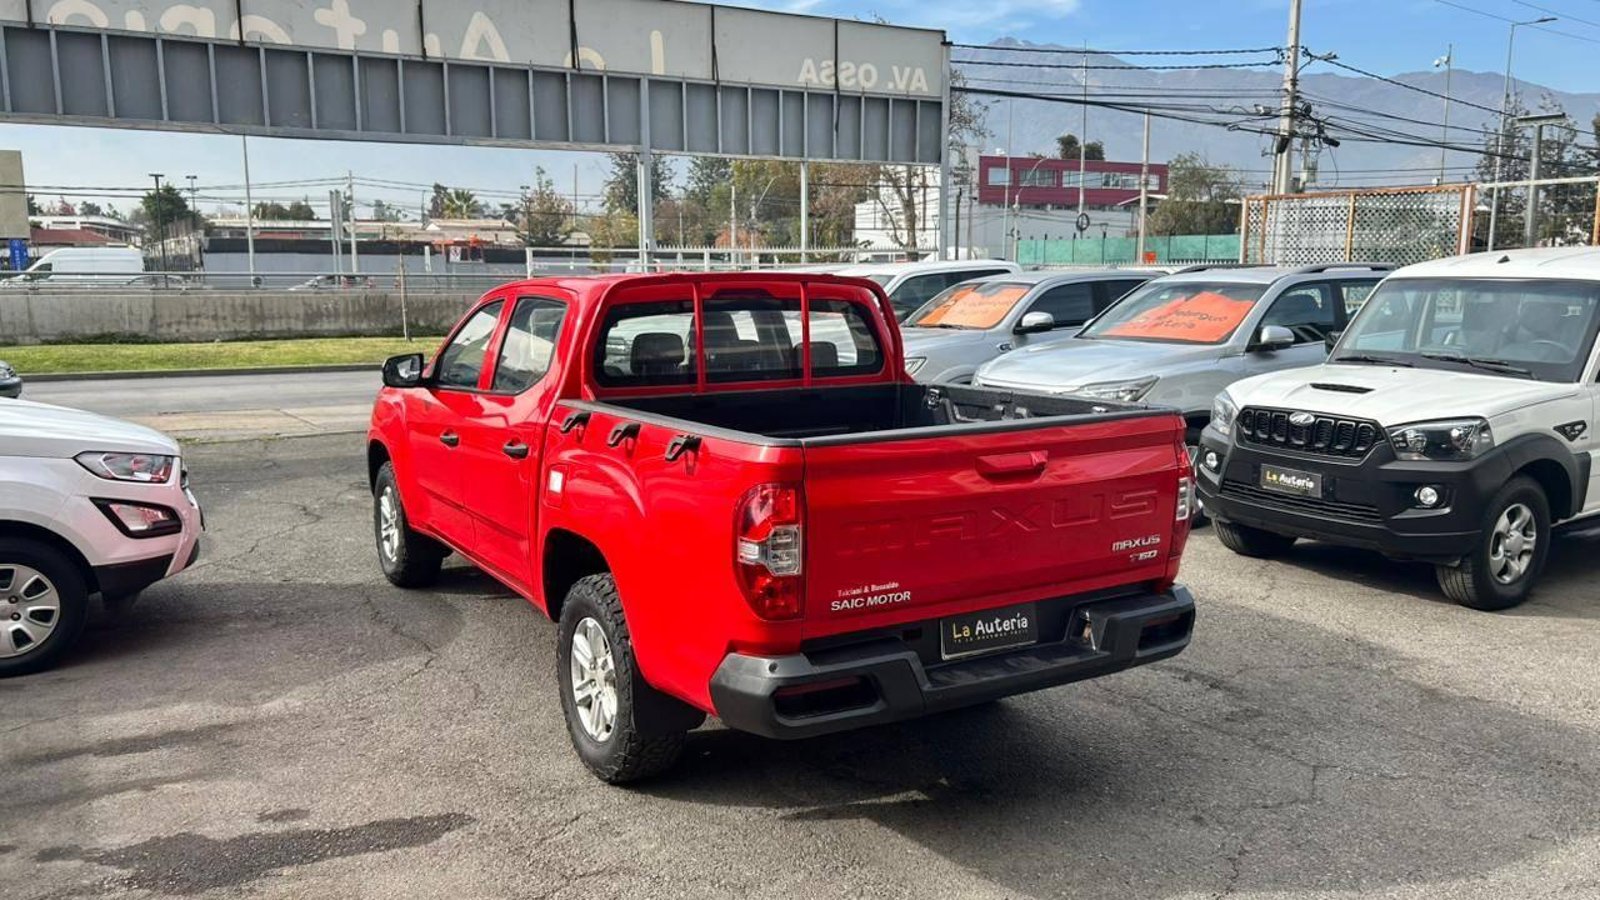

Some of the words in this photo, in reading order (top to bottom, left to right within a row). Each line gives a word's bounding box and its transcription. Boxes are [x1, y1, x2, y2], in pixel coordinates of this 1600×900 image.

[1112, 534, 1161, 551] MAXUS
[831, 598, 865, 611] SAIC
[866, 591, 911, 606] MOTOR
[952, 622, 971, 639] La
[975, 612, 1029, 636] Autería
